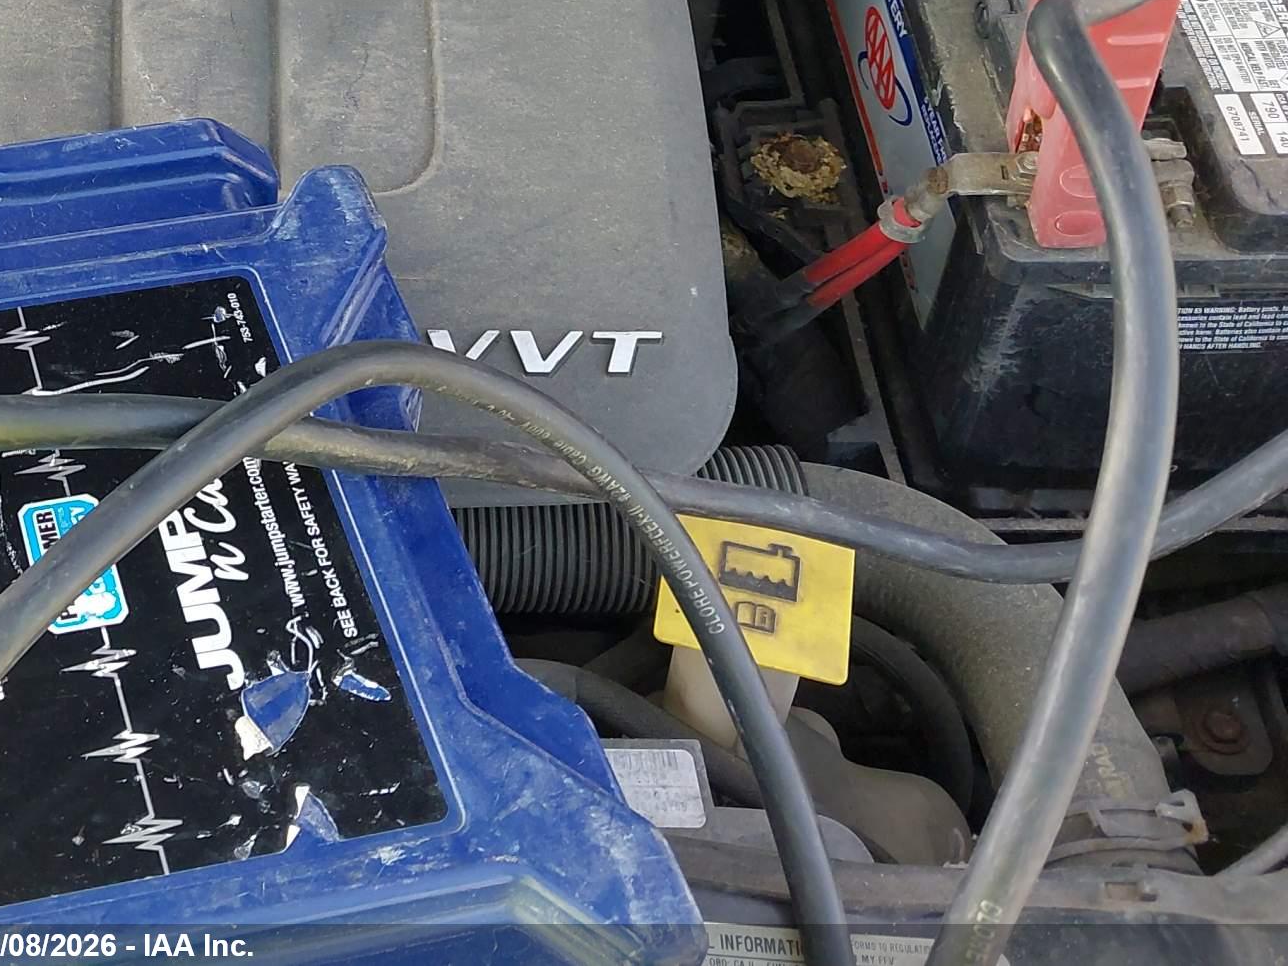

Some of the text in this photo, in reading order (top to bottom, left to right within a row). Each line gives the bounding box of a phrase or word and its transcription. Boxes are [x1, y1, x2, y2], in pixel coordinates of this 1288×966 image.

[866, 9, 895, 108] AAA
[1262, 101, 1280, 119] 790
[427, 329, 663, 374] VVT
[294, 486, 321, 537] SAFETY
[312, 539, 331, 568] FOR
[158, 510, 244, 691] JUMP
[324, 569, 348, 608] BACK
[336, 609, 358, 638] SEE
[688, 588, 725, 635] CLORE
[720, 935, 804, 957] INFORMATI
